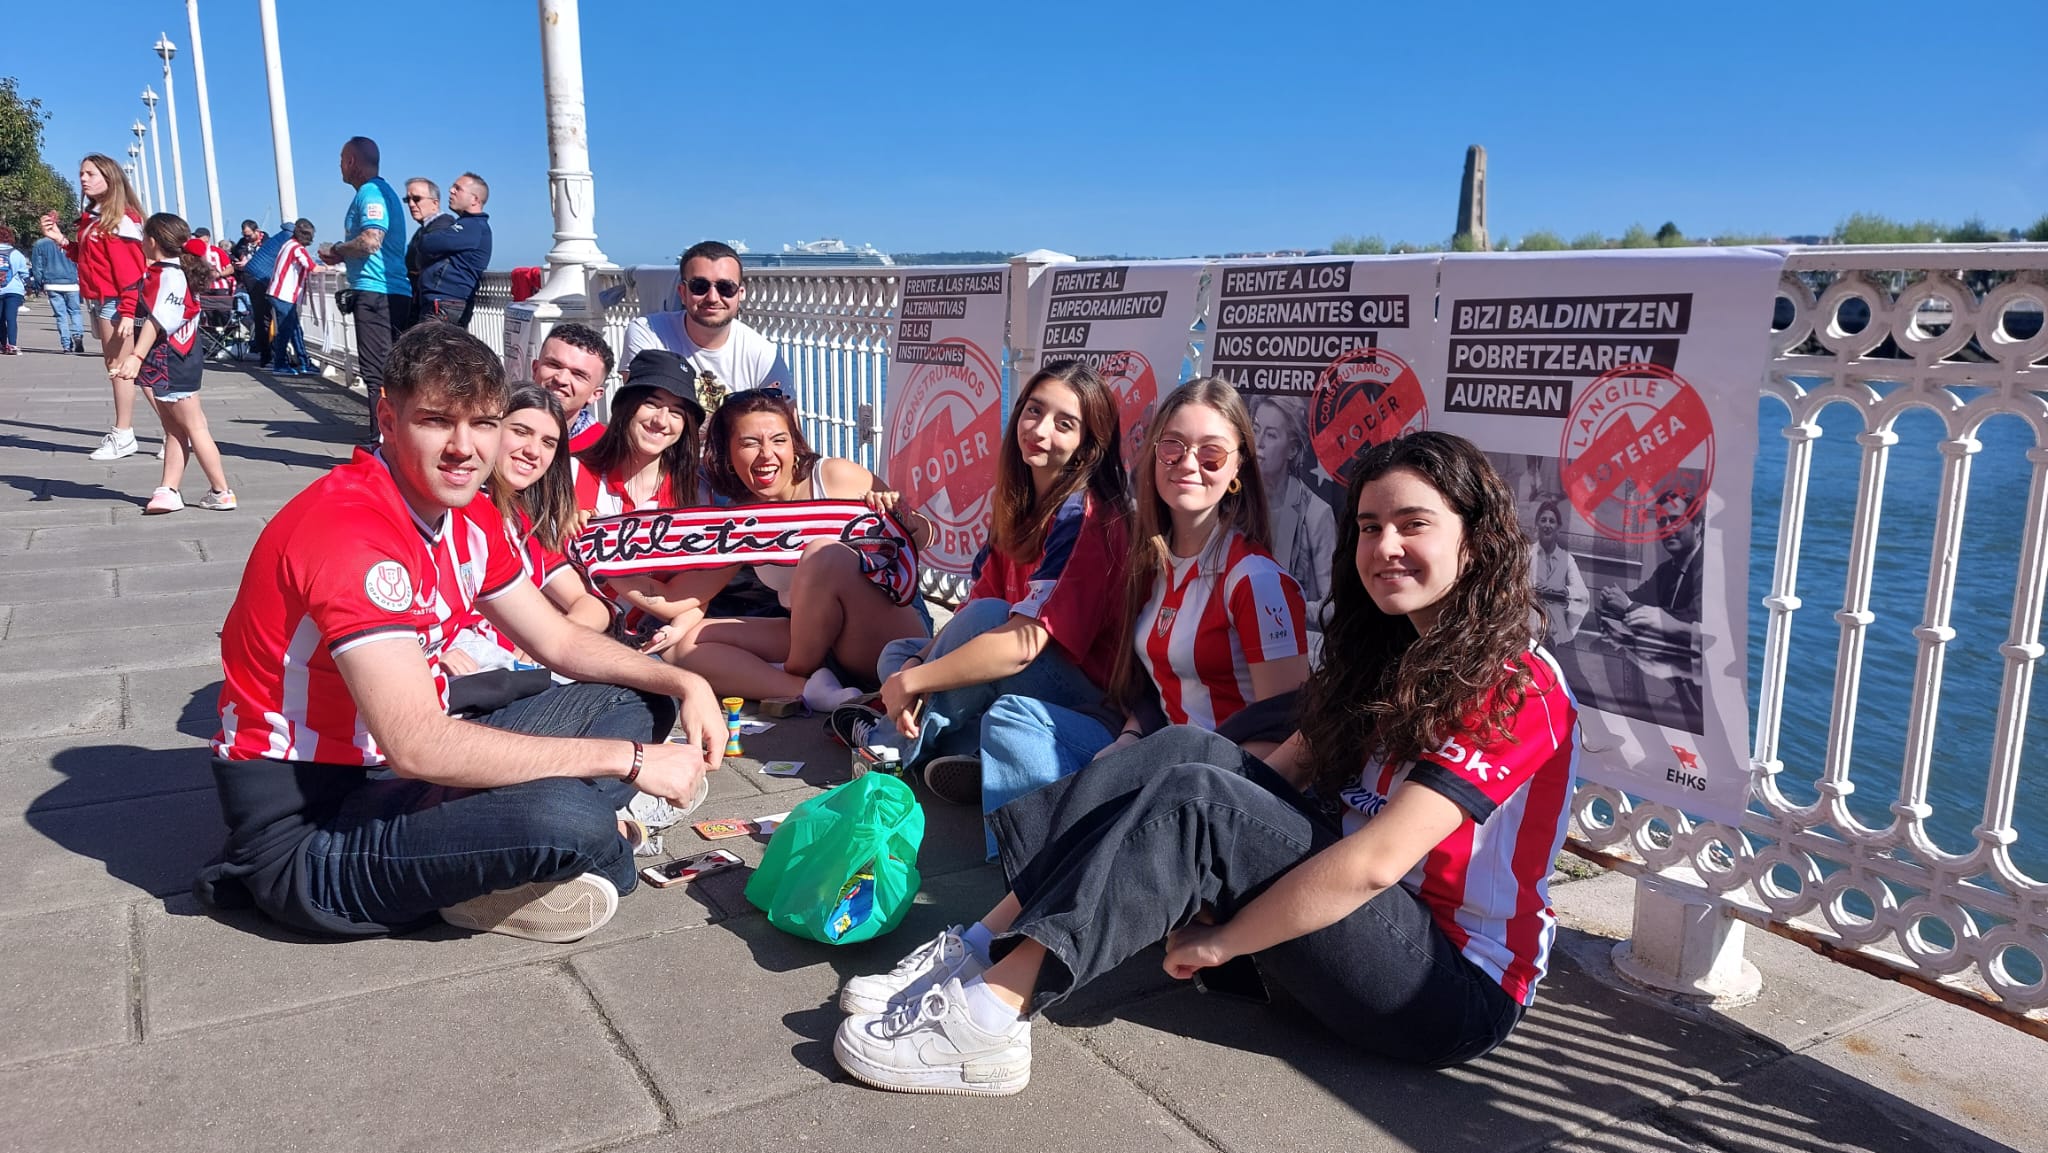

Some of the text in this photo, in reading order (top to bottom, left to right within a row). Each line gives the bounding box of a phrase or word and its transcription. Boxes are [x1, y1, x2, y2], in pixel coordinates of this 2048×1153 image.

[906, 275, 1000, 294] FRENTE A LAS FALSAS
[1055, 271, 1120, 291] FRENTE AL
[1226, 265, 1346, 293] FRENTE A LOS
[903, 300, 965, 316] ALTERNATIVAS
[1050, 295, 1162, 318] EMPEORAMIENTO
[1222, 300, 1405, 325] GOBERNANTES QUE
[1458, 301, 1680, 330] BIZI BALDINTZEN
[901, 323, 929, 338] DE LAS
[1045, 326, 1085, 345] DE LAS
[898, 345, 964, 362] INSTITUCIONES
[1218, 335, 1370, 359] NOS CONDUCEN
[1454, 344, 1654, 371] POBRETZEAREN
[1229, 368, 1250, 390] LA
[1254, 368, 1331, 392] GUERRA
[902, 363, 986, 441] CONSTRUYAMOS
[1320, 362, 1391, 425] CONSTRUYAMOS
[1449, 382, 1564, 411] AURREAN
[1336, 395, 1401, 451] PODER
[1573, 378, 1660, 448] LANGILE
[911, 430, 991, 492] PODER
[571, 515, 805, 562] thletic
[1666, 767, 1707, 792] EHKS
